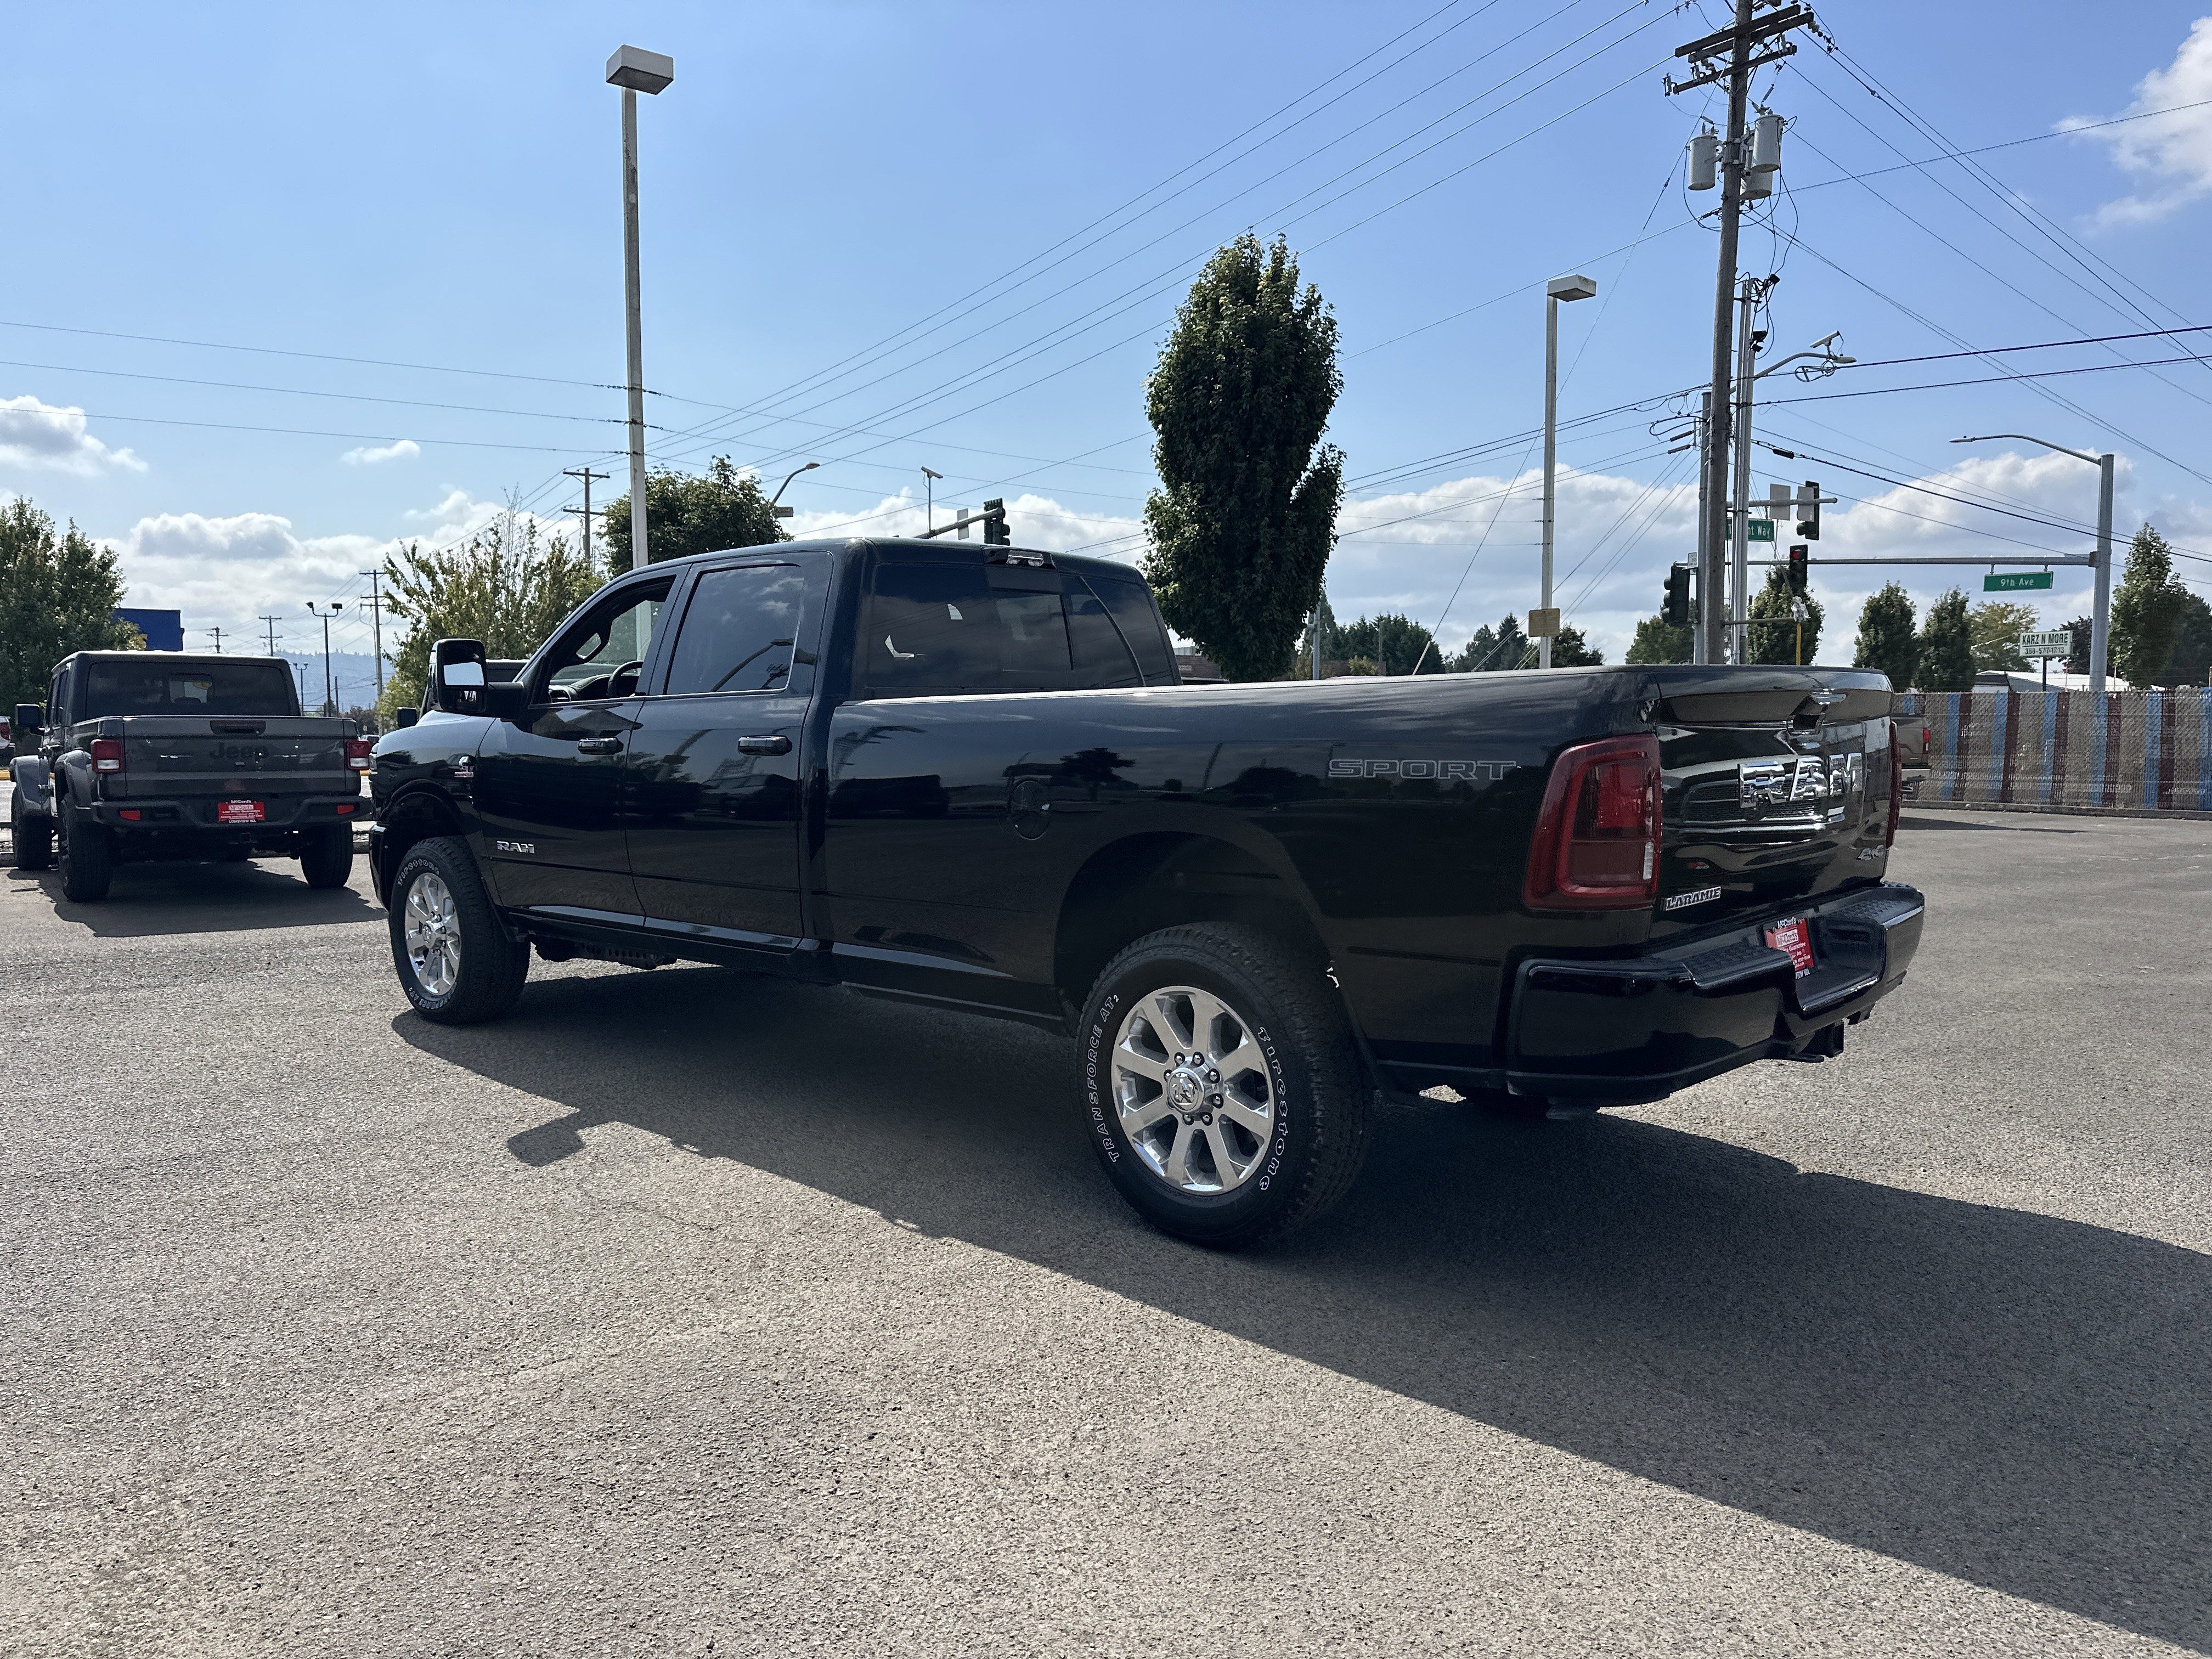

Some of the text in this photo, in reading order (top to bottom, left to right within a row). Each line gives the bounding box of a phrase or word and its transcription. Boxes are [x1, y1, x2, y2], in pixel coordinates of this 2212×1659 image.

[1757, 525, 1770, 539] Way
[2000, 578, 2034, 586] 9th Ave
[2022, 633, 2068, 645] KARZ N MORE
[1328, 759, 1517, 780] SPORT
[1737, 753, 1861, 808] RAM
[497, 840, 535, 854] RAM
[1666, 886, 1721, 911] LARAMIE
[1087, 1025, 1120, 1162] TRANSFORCE
[1257, 1026, 1289, 1190] Firestone
